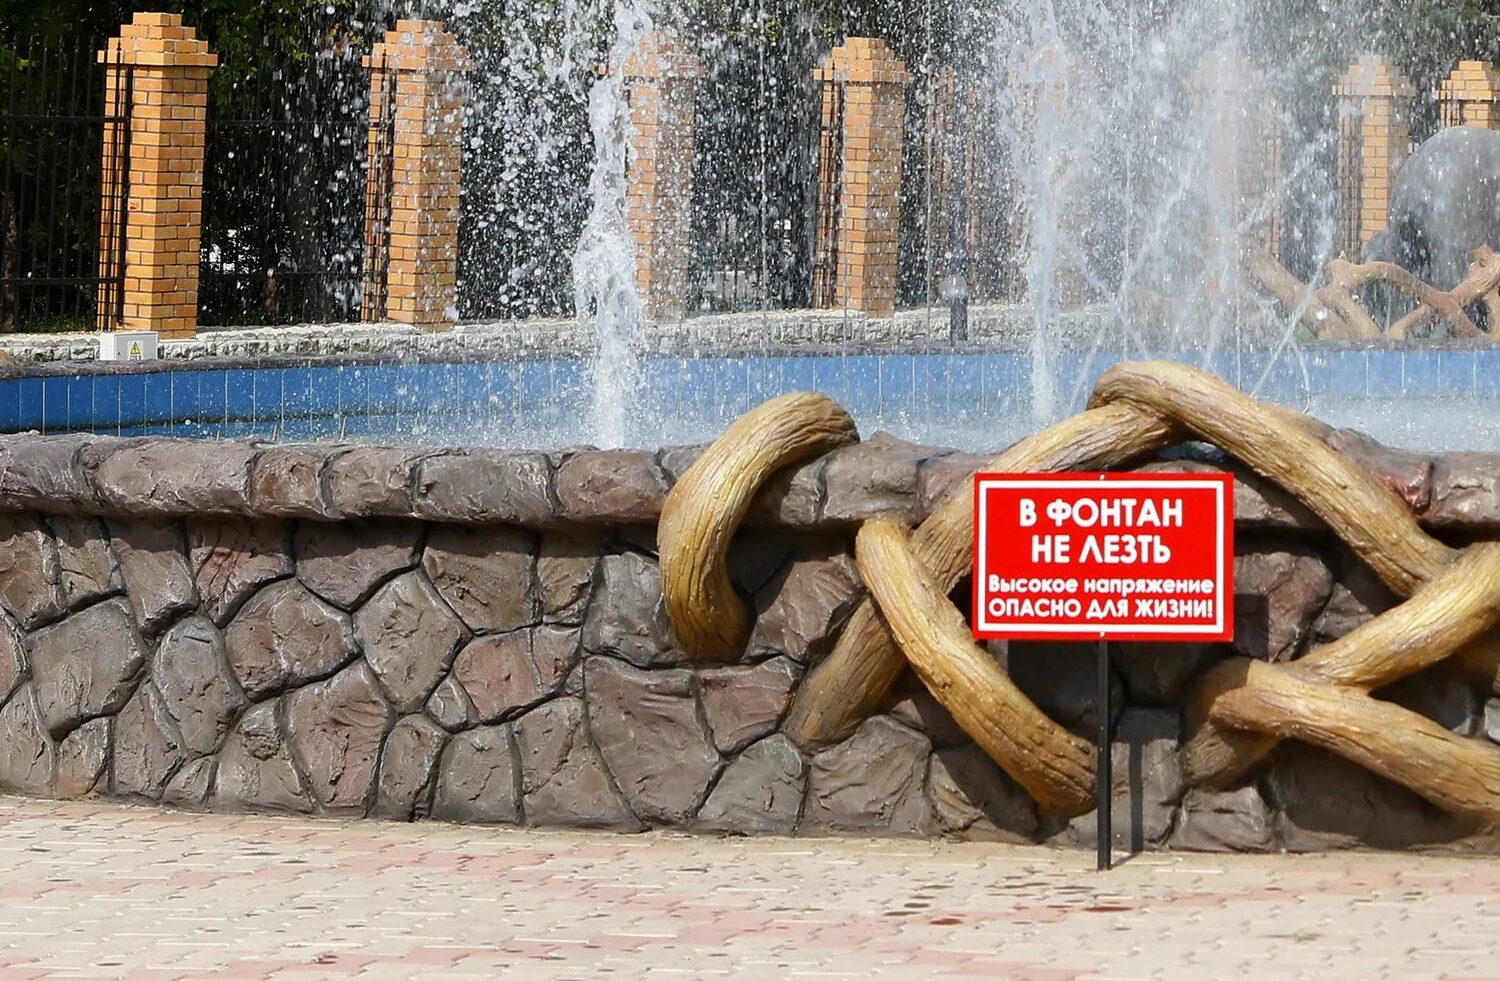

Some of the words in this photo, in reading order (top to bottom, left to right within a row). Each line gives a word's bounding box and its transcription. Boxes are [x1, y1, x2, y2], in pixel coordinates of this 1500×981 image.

[1019, 498, 1038, 527] В
[1046, 498, 1183, 527] ФОНТАН
[1031, 535, 1071, 564] НЕ
[1078, 535, 1171, 564] ЛЕЗТЬ
[988, 574, 1079, 594] Высокое
[1084, 578, 1214, 597] напряжение
[988, 598, 1081, 618] ОПАСНО
[1086, 598, 1129, 620] ДЛЯ
[1135, 599, 1213, 619] ЖИЗНИ!
